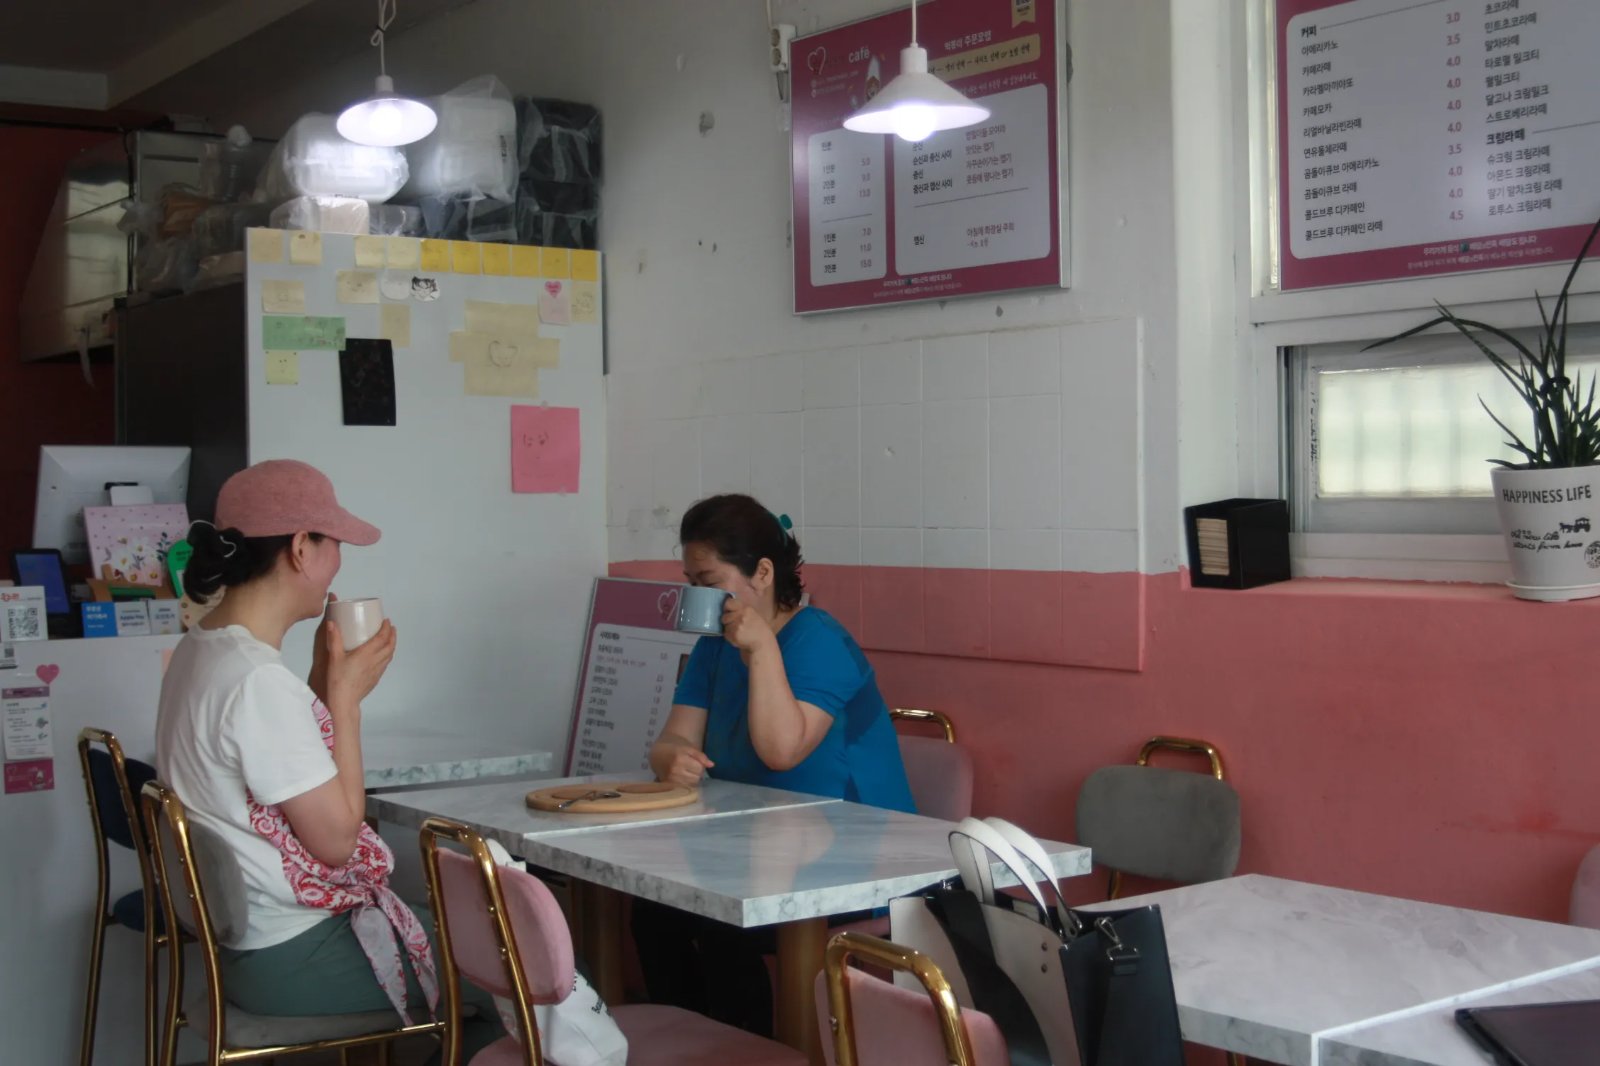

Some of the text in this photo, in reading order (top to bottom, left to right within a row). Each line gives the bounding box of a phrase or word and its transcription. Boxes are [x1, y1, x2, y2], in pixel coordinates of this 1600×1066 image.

[1446, 12, 1461, 25] 3.0
[1484, 12, 1537, 34] 민트초코라떼
[1301, 25, 1317, 38] 커피
[1301, 40, 1339, 57] 아메리카노
[1447, 34, 1461, 47] 3.5
[1485, 34, 1520, 52] 말차라떼
[1447, 55, 1461, 68] 4.0
[1513, 49, 1540, 65] 밀크티
[1302, 62, 1332, 76] 카페라떼
[1302, 78, 1354, 97] 카라멜마끼아또
[1447, 77, 1462, 90] 4.0
[1486, 85, 1549, 107] 달고나 크림밀크
[1303, 102, 1333, 118] 카페모카
[1447, 99, 1462, 112] 4.0
[1486, 103, 1548, 124] 스트로베리라떼
[1303, 118, 1362, 139] 리얼바닐라빈라떼
[1447, 121, 1462, 134] 4.0
[1486, 128, 1526, 145] 크림라떼
[1304, 142, 1348, 159] 연유돌체라떼
[1448, 143, 1462, 156] 3.5
[1514, 145, 1551, 162] 크림라떼
[1304, 158, 1381, 180] 곰돌이큐브 아메리카노
[1448, 165, 1463, 178] 4.0
[1487, 162, 1551, 183] 아몬드 크림라떼
[1304, 182, 1358, 201] 곰돌이큐브 라떼
[1449, 187, 1464, 200] 4.0
[1506, 181, 1543, 199] 말차크림
[1544, 178, 1563, 192] 라떼
[1304, 202, 1366, 221] 콜드브루 디카페인
[1449, 209, 1464, 222] 4.5
[1488, 197, 1552, 218] 로투스 크림라떼
[1305, 220, 1384, 242] 콜드브루 디카페인 라떼
[1502, 485, 1592, 504] HAPPINESS LIFE
